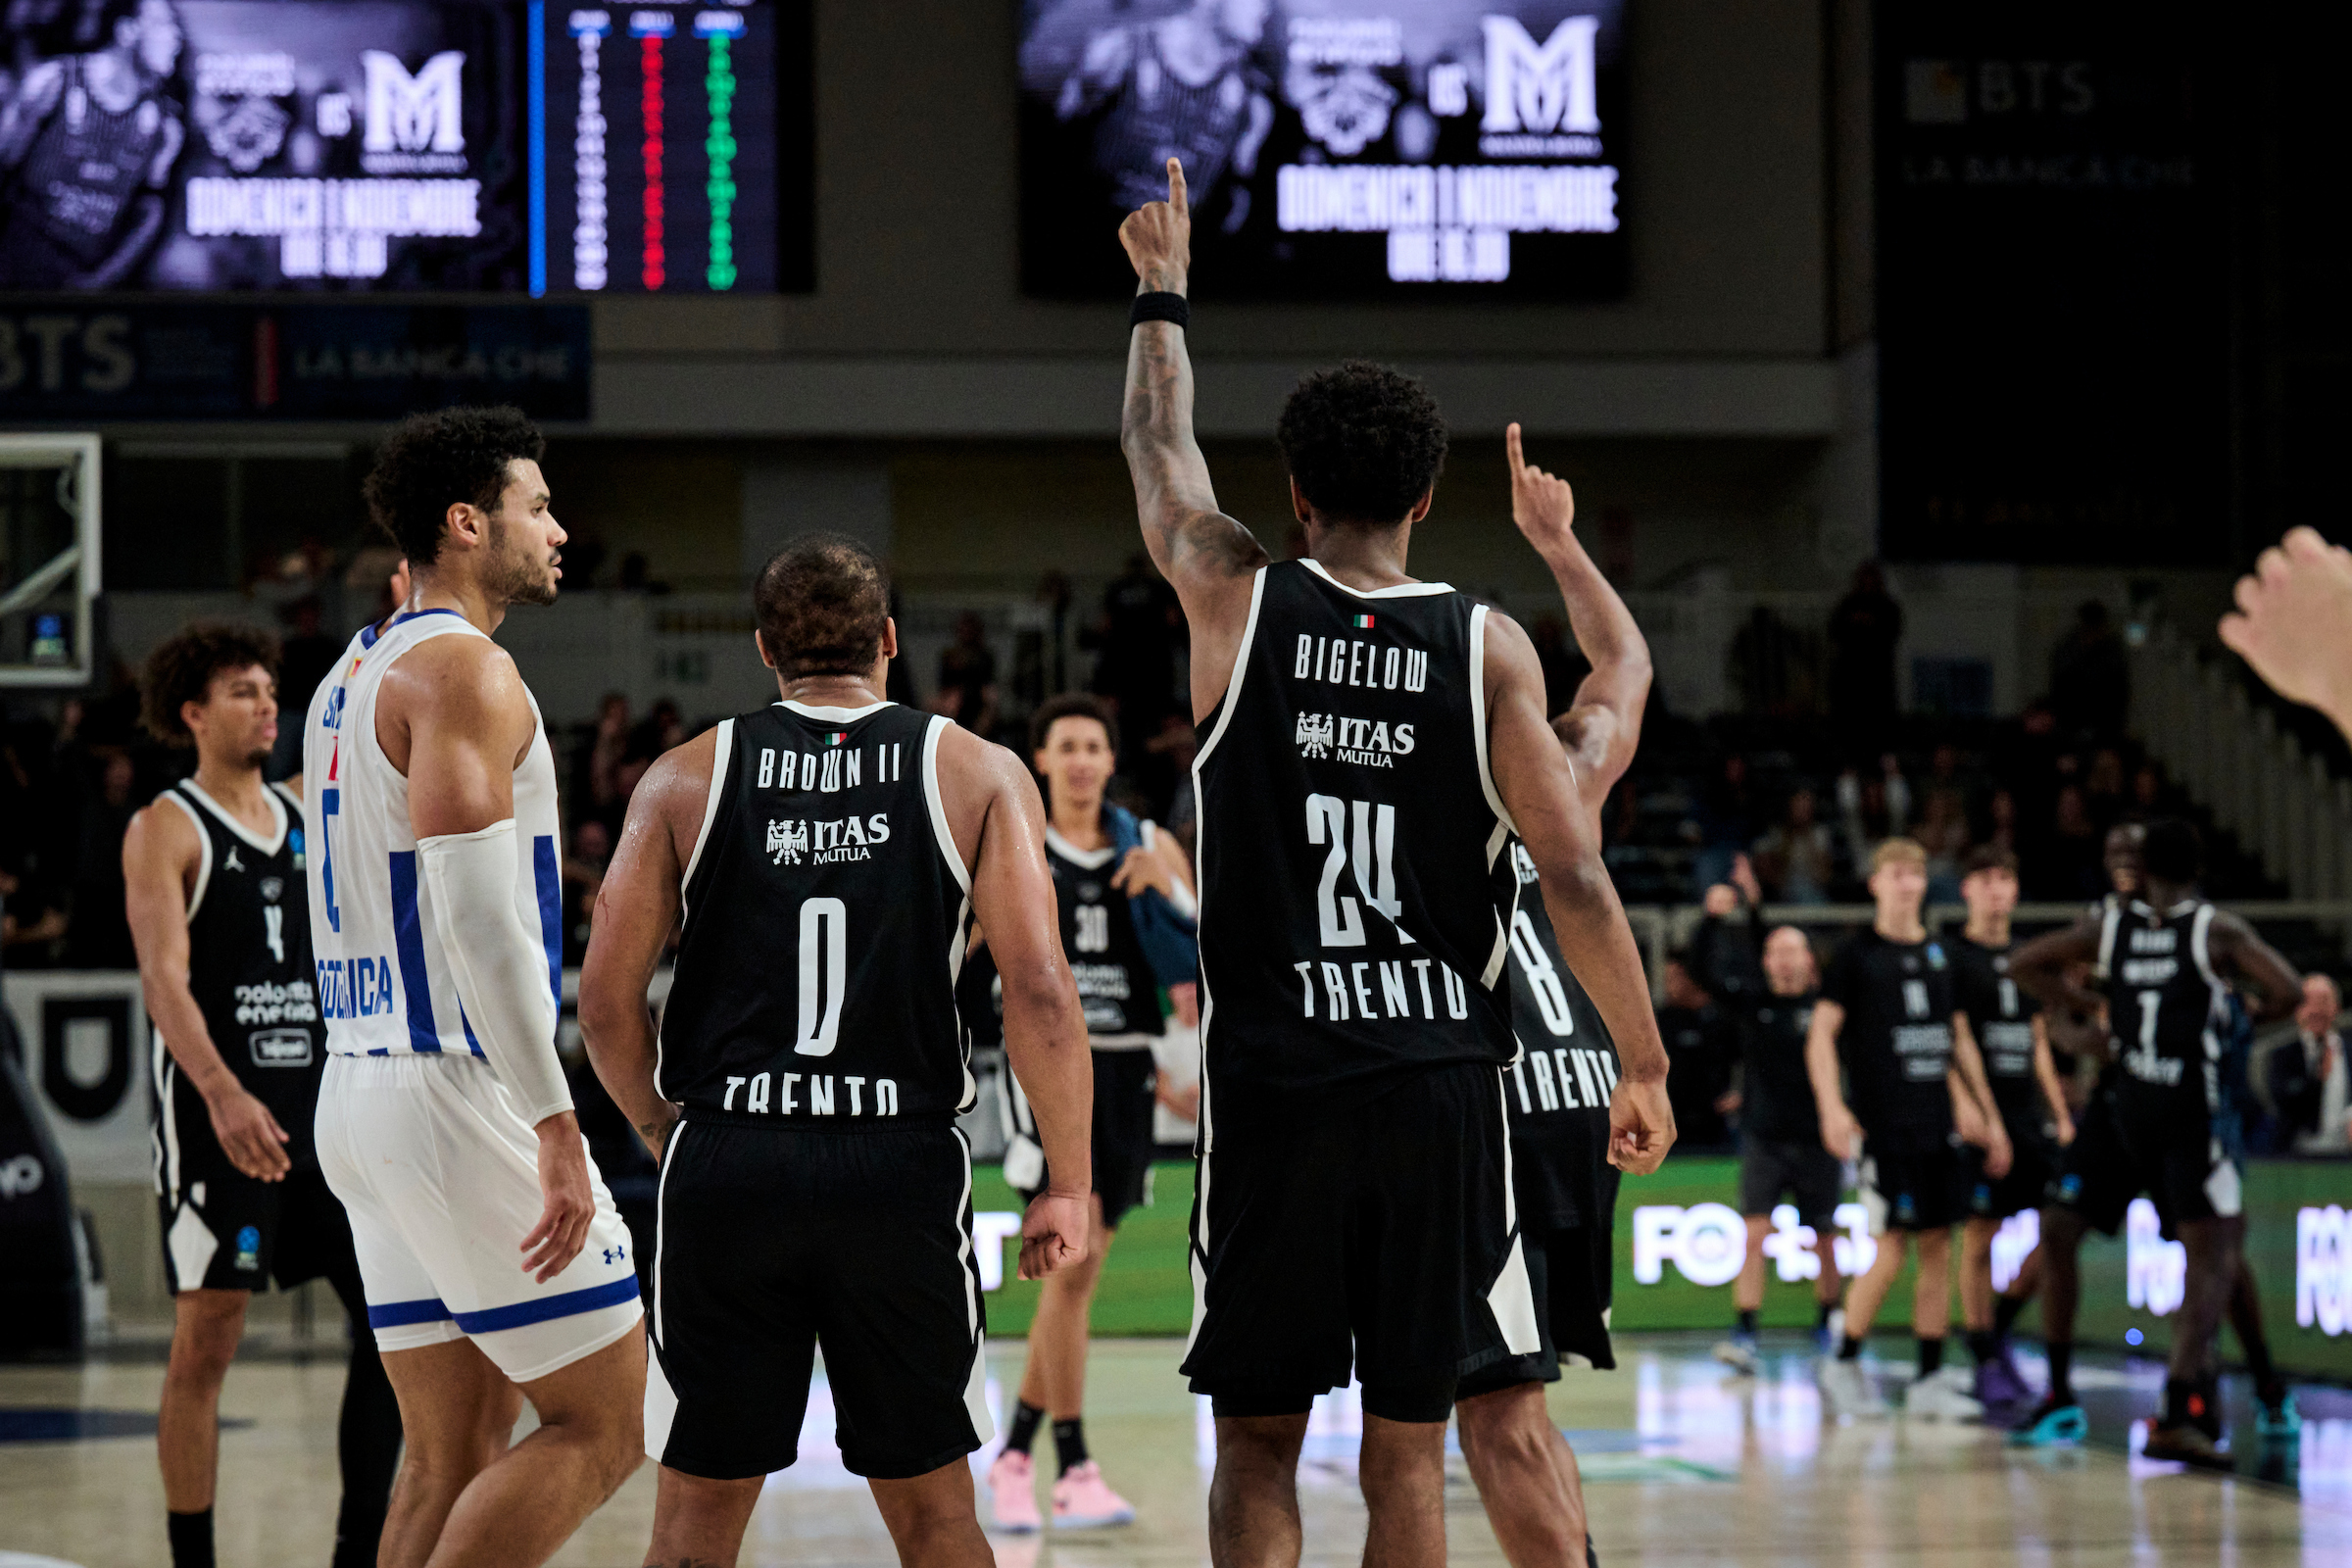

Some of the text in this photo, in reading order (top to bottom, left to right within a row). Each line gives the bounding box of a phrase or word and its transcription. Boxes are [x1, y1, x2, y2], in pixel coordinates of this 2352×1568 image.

[1295, 633, 1428, 693] BIGELOW
[1336, 748, 1394, 768] MUTUA
[1337, 716, 1415, 756] ITAS
[758, 743, 900, 793] BROWN II
[812, 847, 871, 865] MUTUA
[813, 812, 890, 851] ITAS
[1305, 792, 1418, 948] 24
[794, 897, 847, 1057] 0
[1293, 957, 1468, 1021] TRENTO
[1510, 908, 1574, 1037] 8
[723, 1071, 899, 1116] TRENTO
